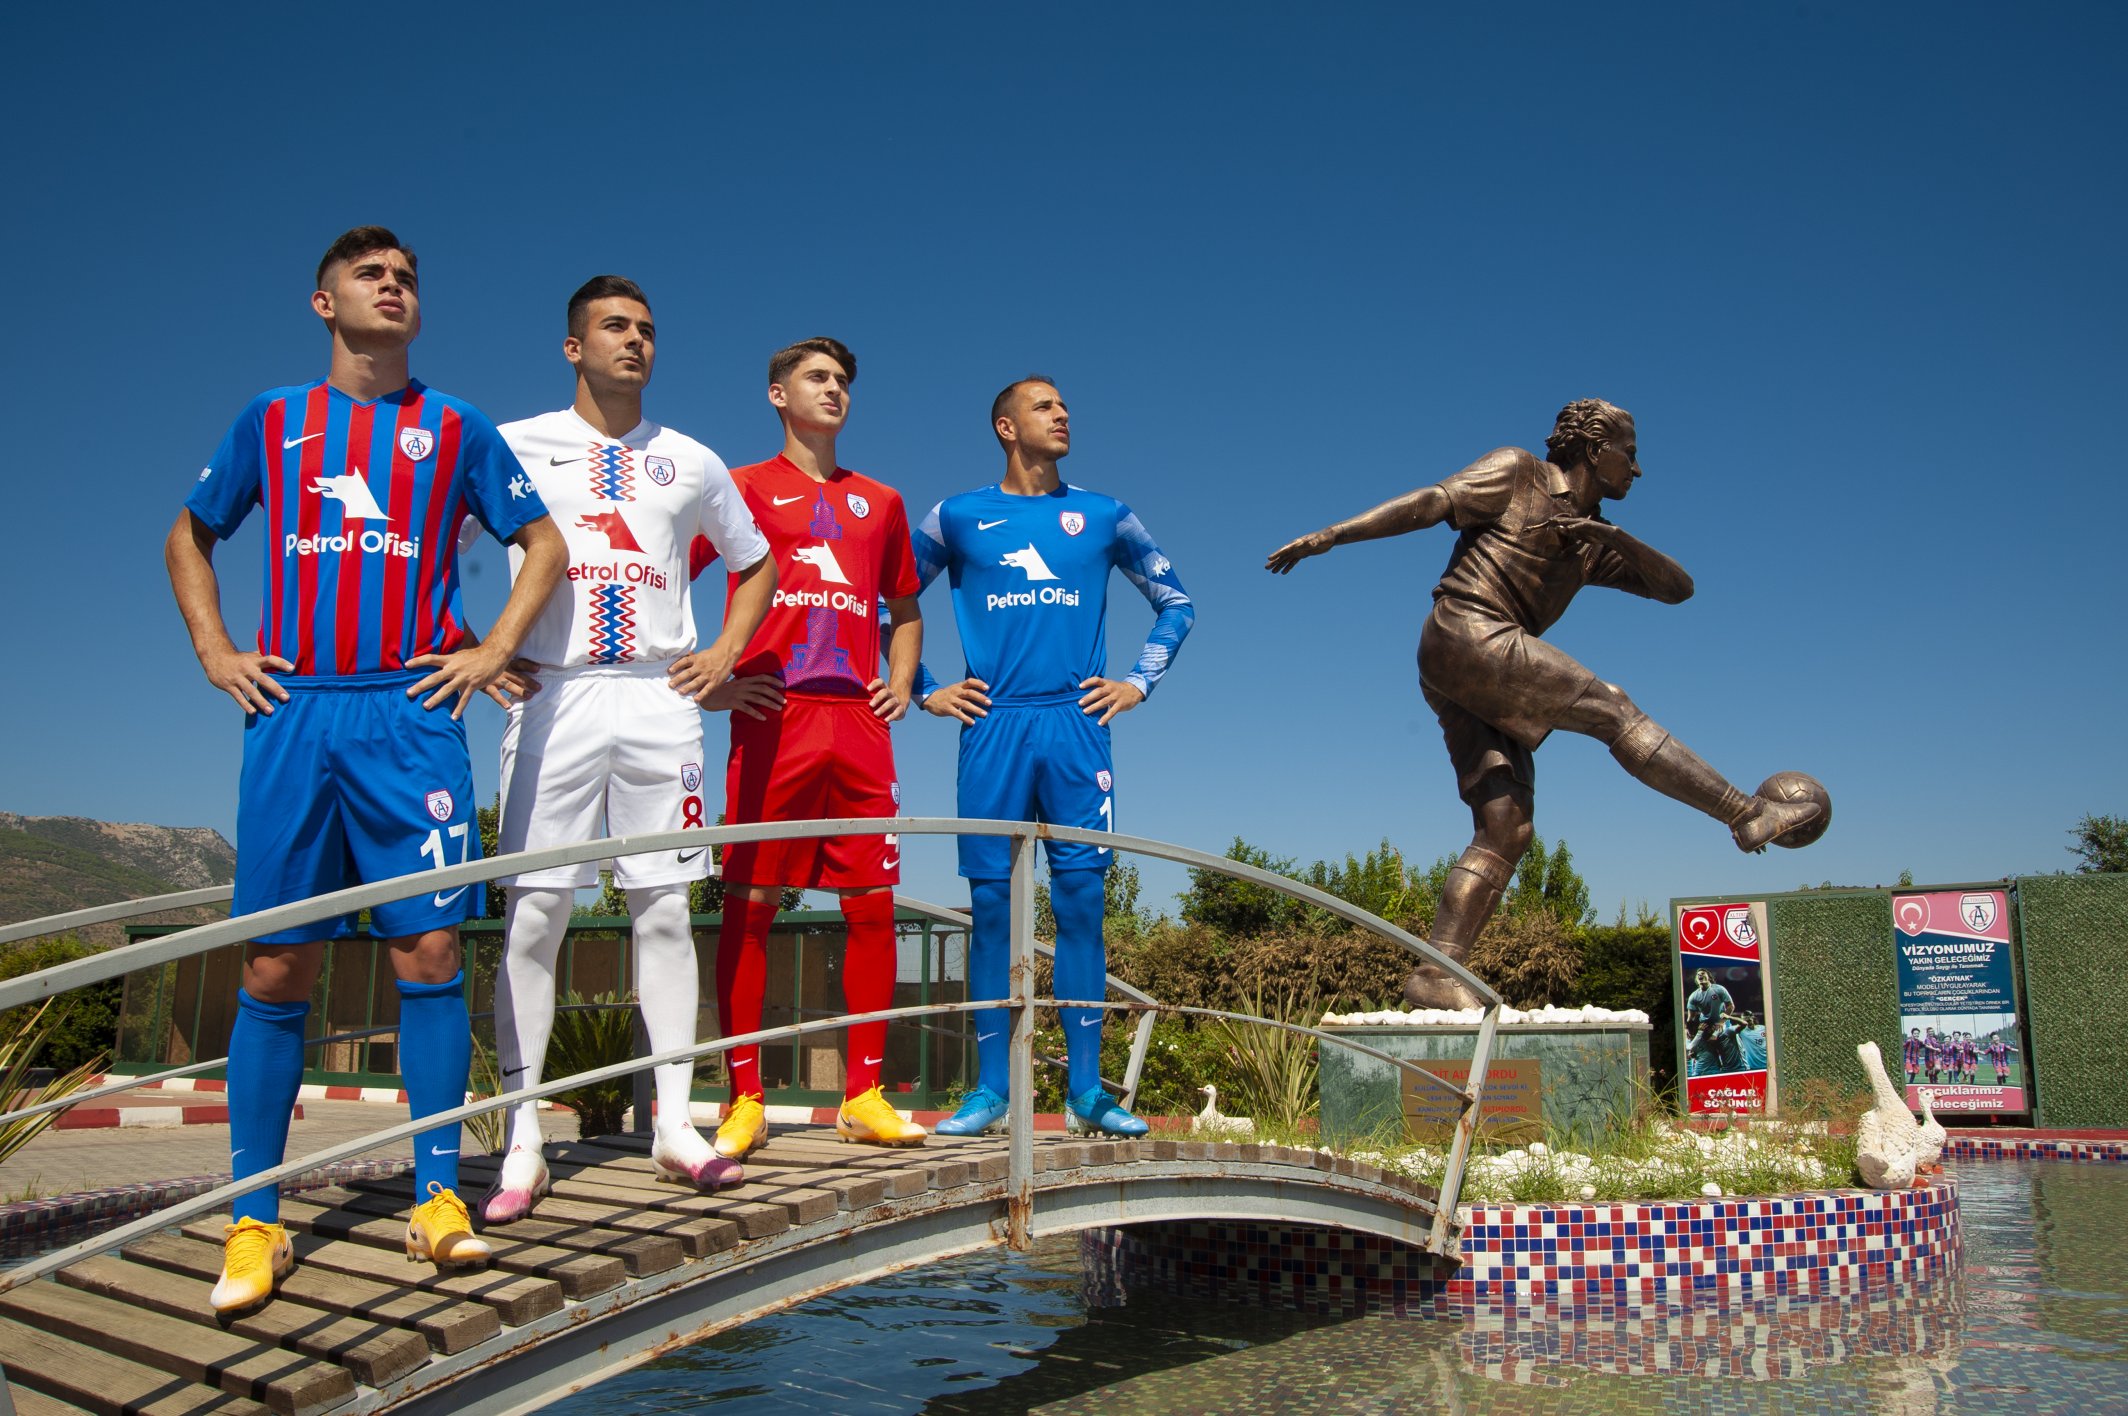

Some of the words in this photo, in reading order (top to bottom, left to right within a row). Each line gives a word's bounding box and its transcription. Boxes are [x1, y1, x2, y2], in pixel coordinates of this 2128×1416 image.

[285, 530, 354, 557] Petrol
[359, 530, 420, 559] Ofisi
[566, 561, 618, 581] etrol
[624, 562, 667, 590] Ofisi
[772, 589, 828, 608] Petrol
[831, 591, 868, 618] Ofisi
[986, 588, 1036, 612] Petrol
[1039, 587, 1080, 607] Ofisi
[420, 822, 469, 870] 17
[1902, 942, 1996, 956] VİZYONUMUZ
[1908, 957, 1933, 965] YAKIN
[1934, 954, 1991, 963] GELECEĞİMİZ
[1432, 1069, 1449, 1080] AİT
[1452, 1069, 1517, 1079] ALTORDU
[1708, 1087, 1757, 1099] ÇAĞLAR
[1931, 1098, 2004, 1110] eleceğimiz
